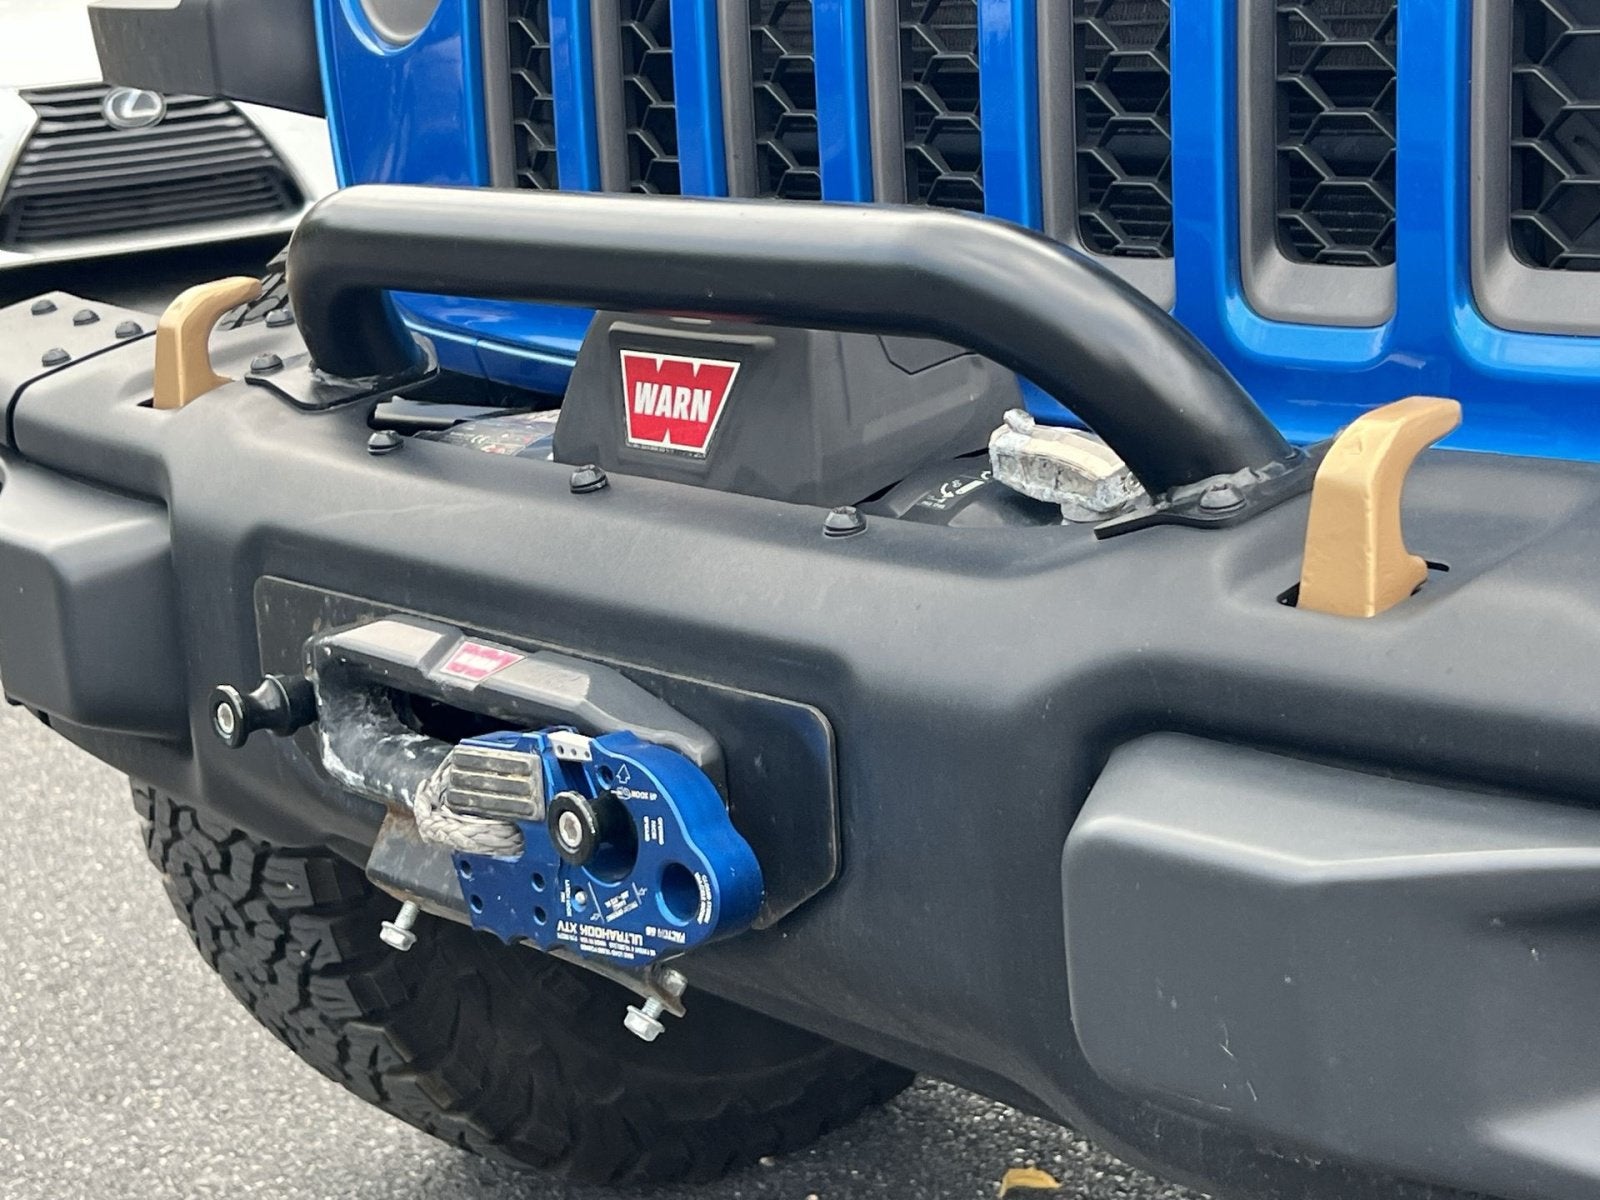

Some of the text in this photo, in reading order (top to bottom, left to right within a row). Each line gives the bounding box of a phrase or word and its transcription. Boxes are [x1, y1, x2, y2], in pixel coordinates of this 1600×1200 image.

[634, 381, 712, 423] WARN
[557, 920, 578, 934] XTV
[579, 923, 643, 947] ULTRAHOOK
[657, 929, 686, 944] FACTOR
